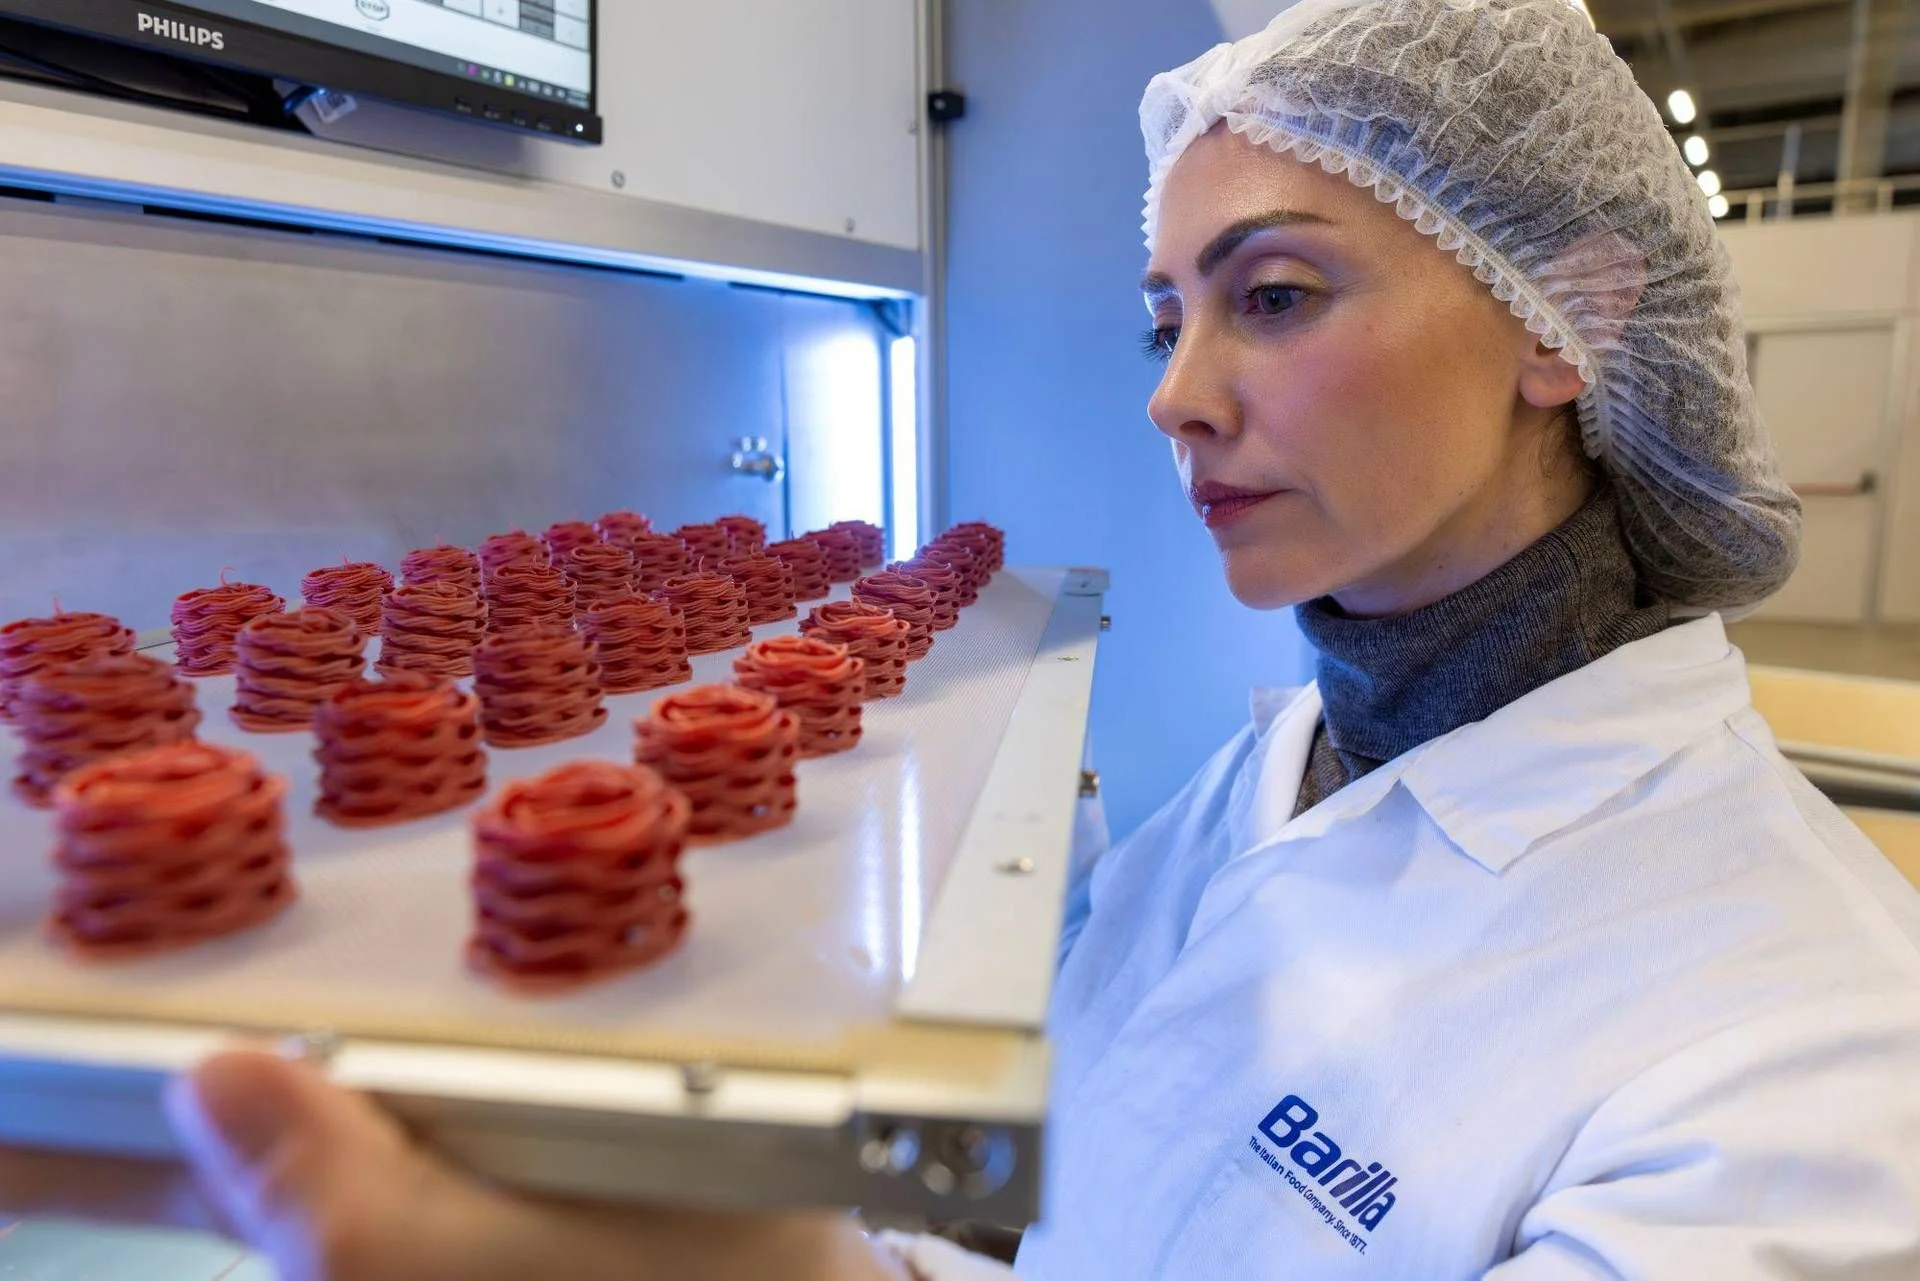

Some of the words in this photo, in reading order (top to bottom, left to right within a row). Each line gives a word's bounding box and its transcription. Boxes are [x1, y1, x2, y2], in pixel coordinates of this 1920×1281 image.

[138, 12, 224, 50] PHILIPS
[1249, 1136, 1261, 1153] The
[1259, 1147, 1284, 1175] Italian
[1284, 1170, 1307, 1194] Food
[1334, 1219, 1351, 1240] Since
[1350, 1233, 1367, 1256] 1877.
[1258, 1094, 1398, 1232] Barilla
